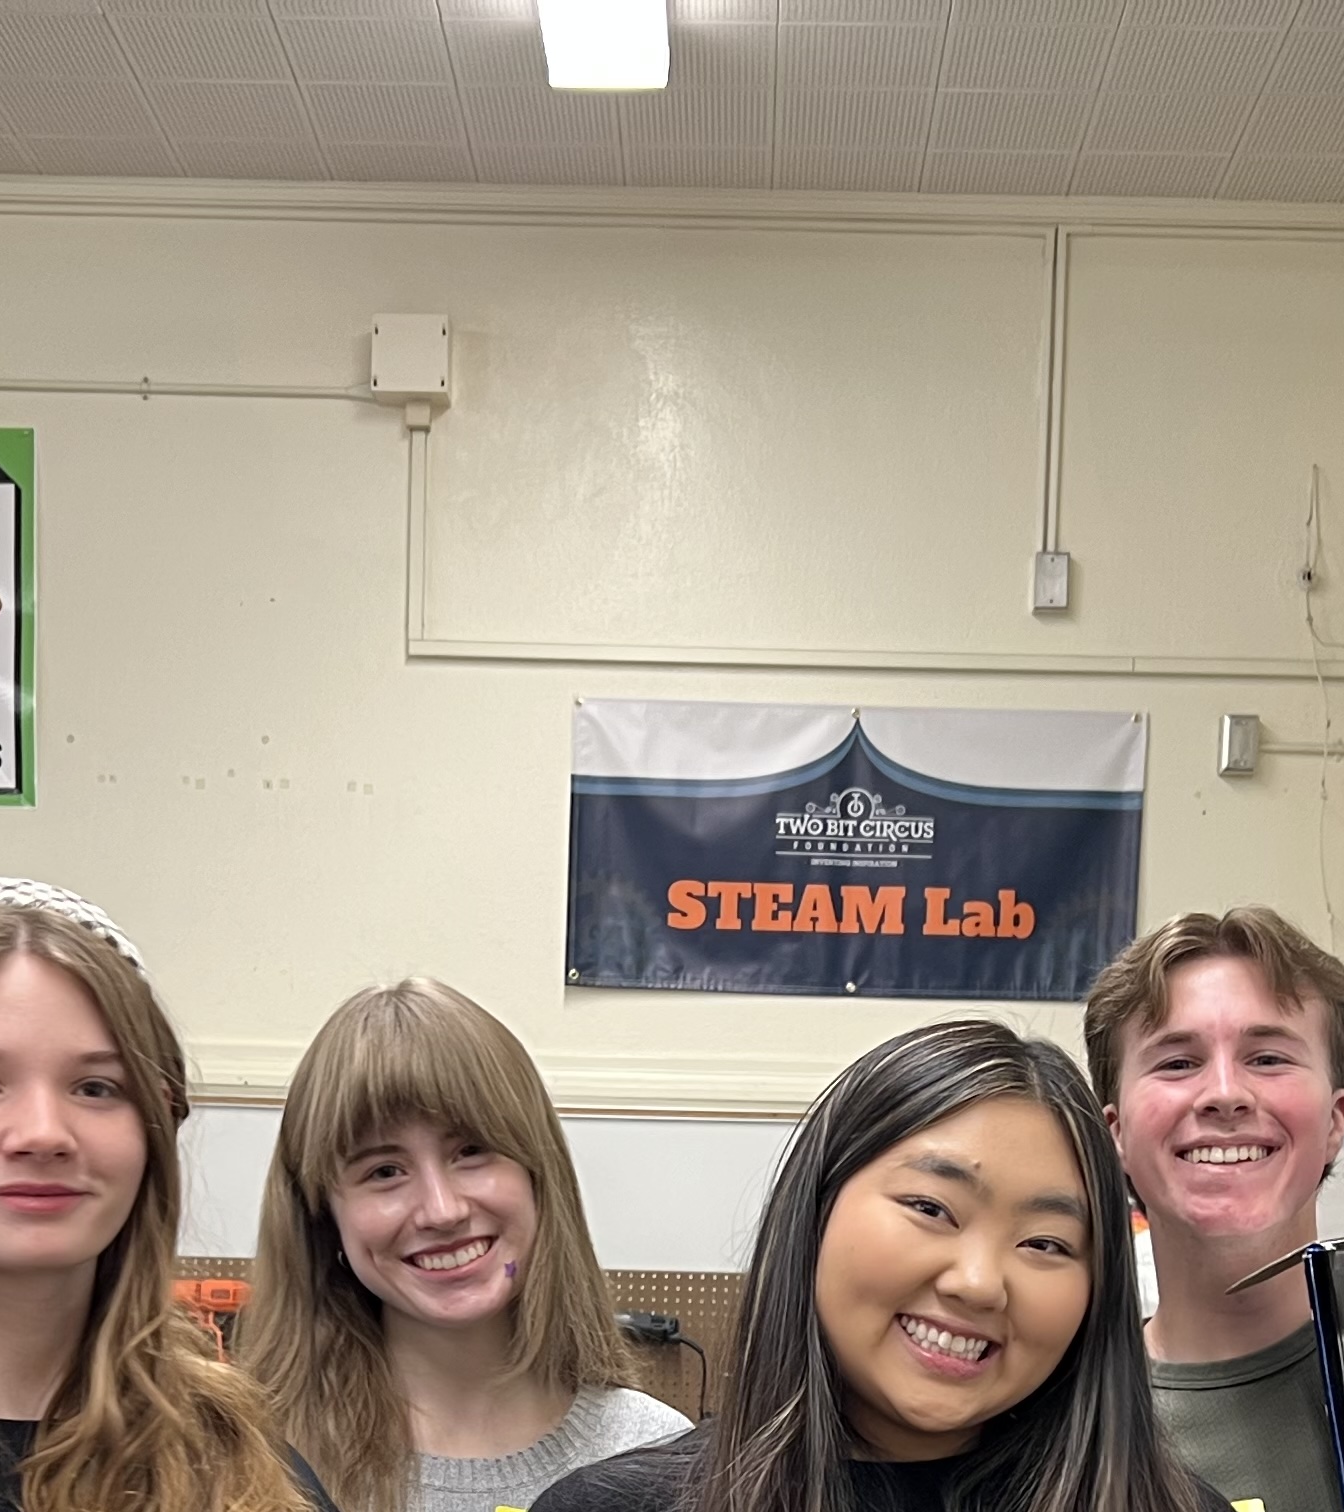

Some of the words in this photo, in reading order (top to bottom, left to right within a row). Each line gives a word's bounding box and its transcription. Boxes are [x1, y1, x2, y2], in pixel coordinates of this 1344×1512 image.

[775, 814, 824, 836] TWO
[826, 819, 857, 837] BIT
[859, 819, 935, 842] CIRCUS
[792, 840, 909, 853] FOUNDATION
[666, 879, 906, 935] STEAM
[922, 887, 1036, 939] Lab
